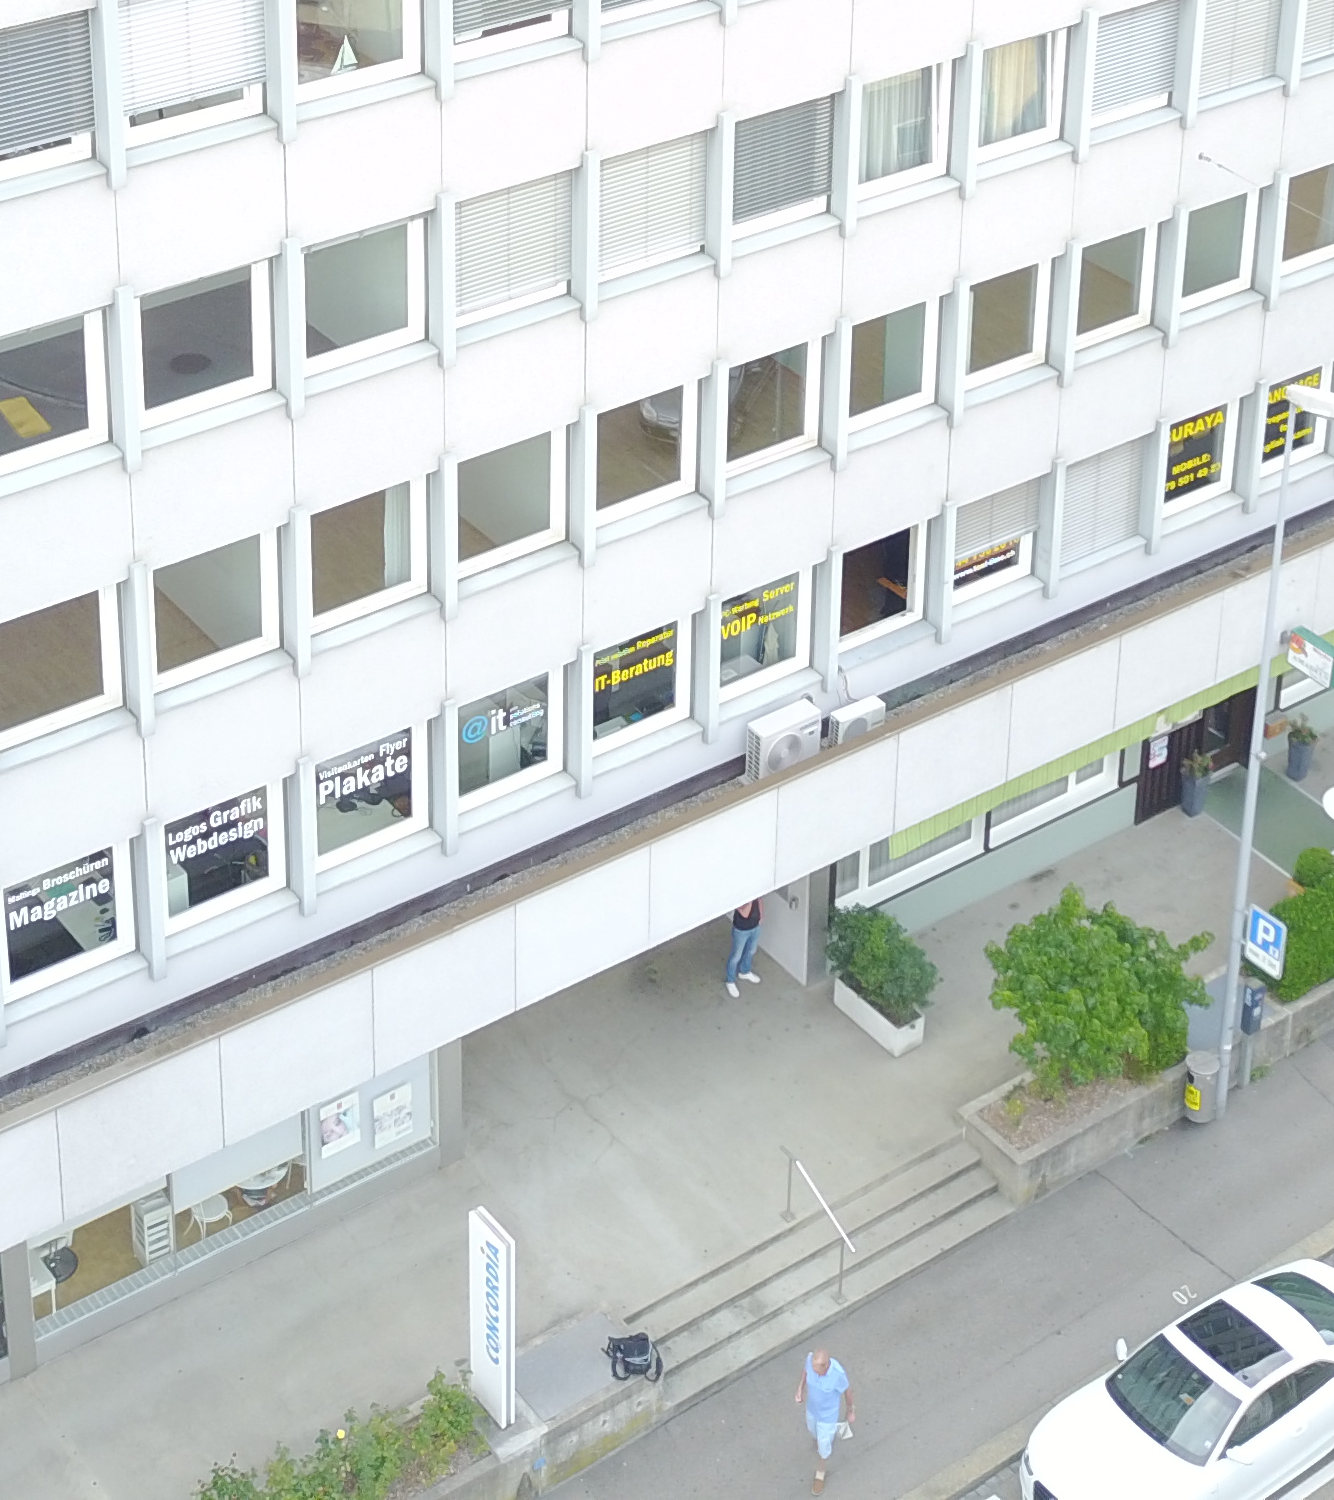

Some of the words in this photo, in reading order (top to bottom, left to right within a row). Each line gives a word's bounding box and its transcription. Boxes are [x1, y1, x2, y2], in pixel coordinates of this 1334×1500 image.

[1169, 411, 1224, 442] URAYA
[721, 612, 757, 640] VOIP
[595, 650, 674, 693] IT-Beratung
[379, 738, 408, 757] Flyer
[319, 755, 408, 805] Plakate
[168, 822, 207, 846] Logos
[209, 795, 262, 827] Grafik
[169, 817, 264, 865] Webdesign
[42, 857, 109, 891] Broschüren
[9, 878, 110, 931] Magazine
[1256, 917, 1275, 946] P
